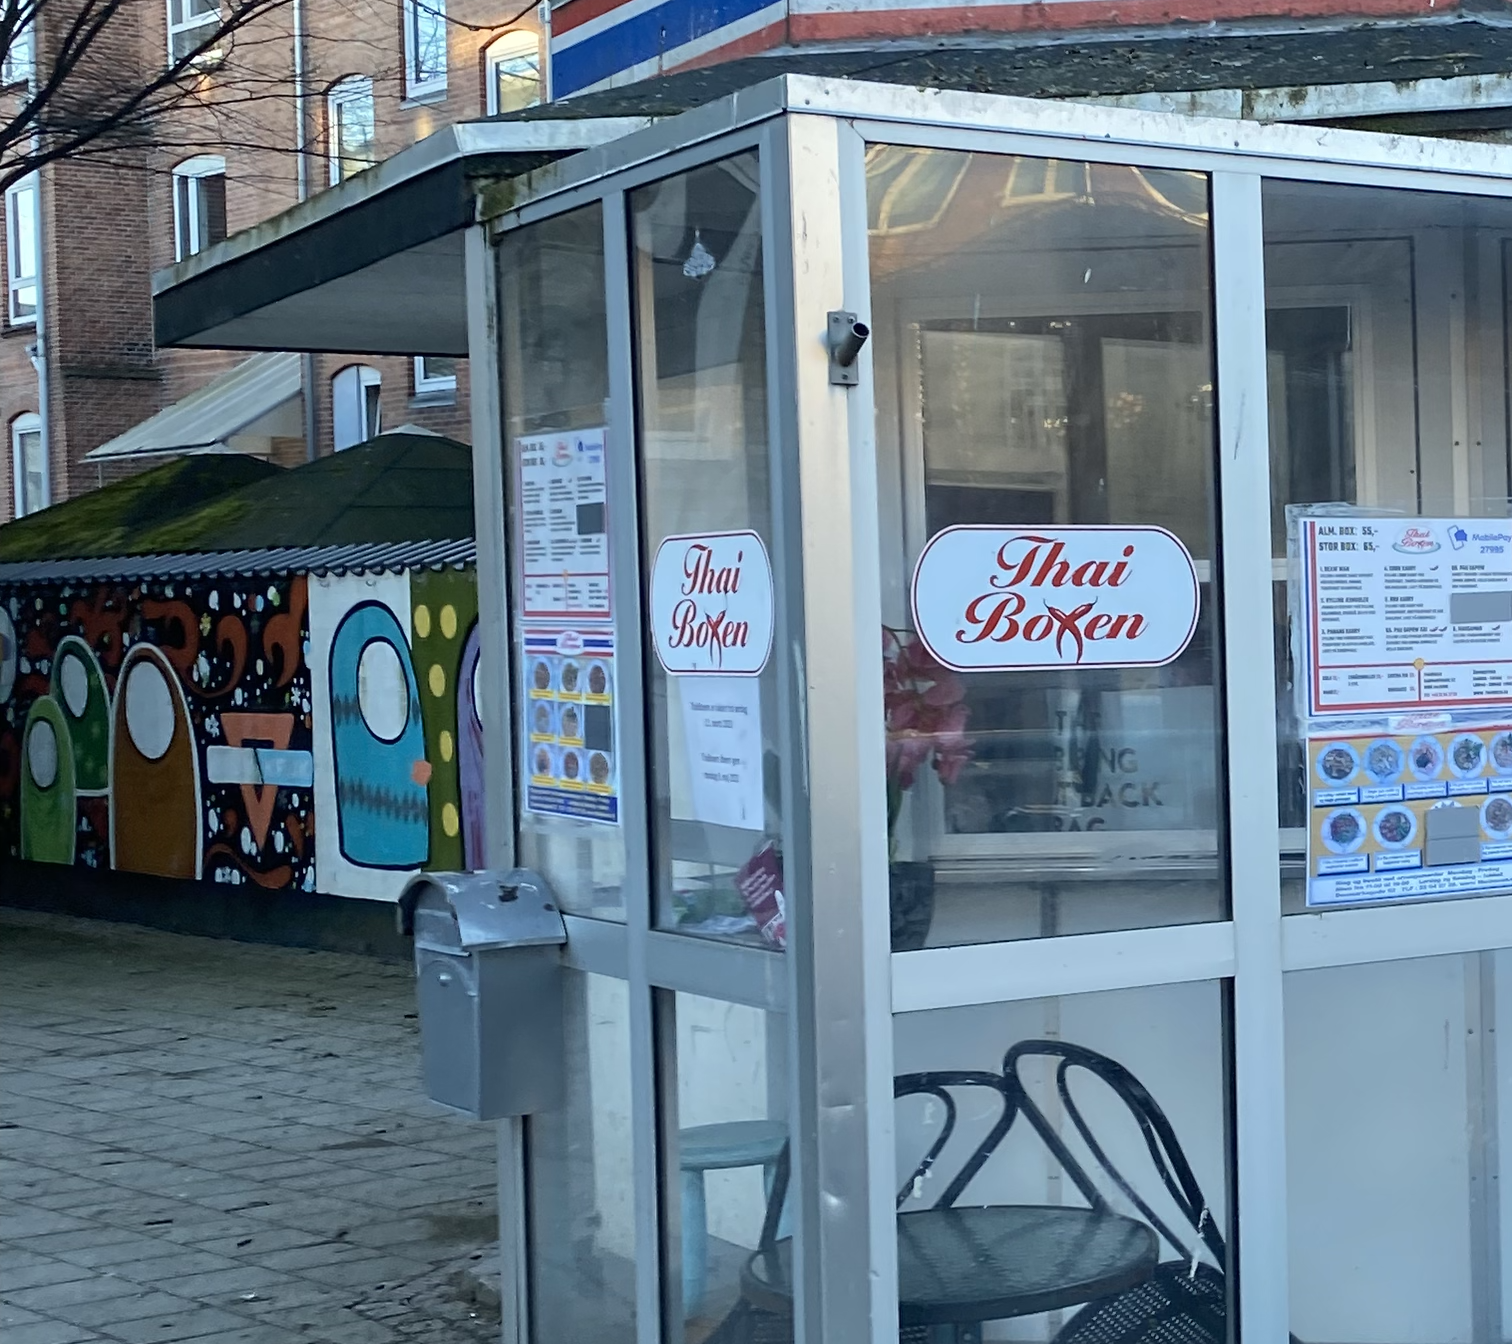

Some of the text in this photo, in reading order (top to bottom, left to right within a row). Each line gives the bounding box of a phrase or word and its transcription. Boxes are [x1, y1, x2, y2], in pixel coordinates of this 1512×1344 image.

[681, 544, 743, 596] Thai
[989, 535, 1135, 589] Thai
[669, 599, 749, 669] Boxen
[955, 591, 1149, 664] Boxen
